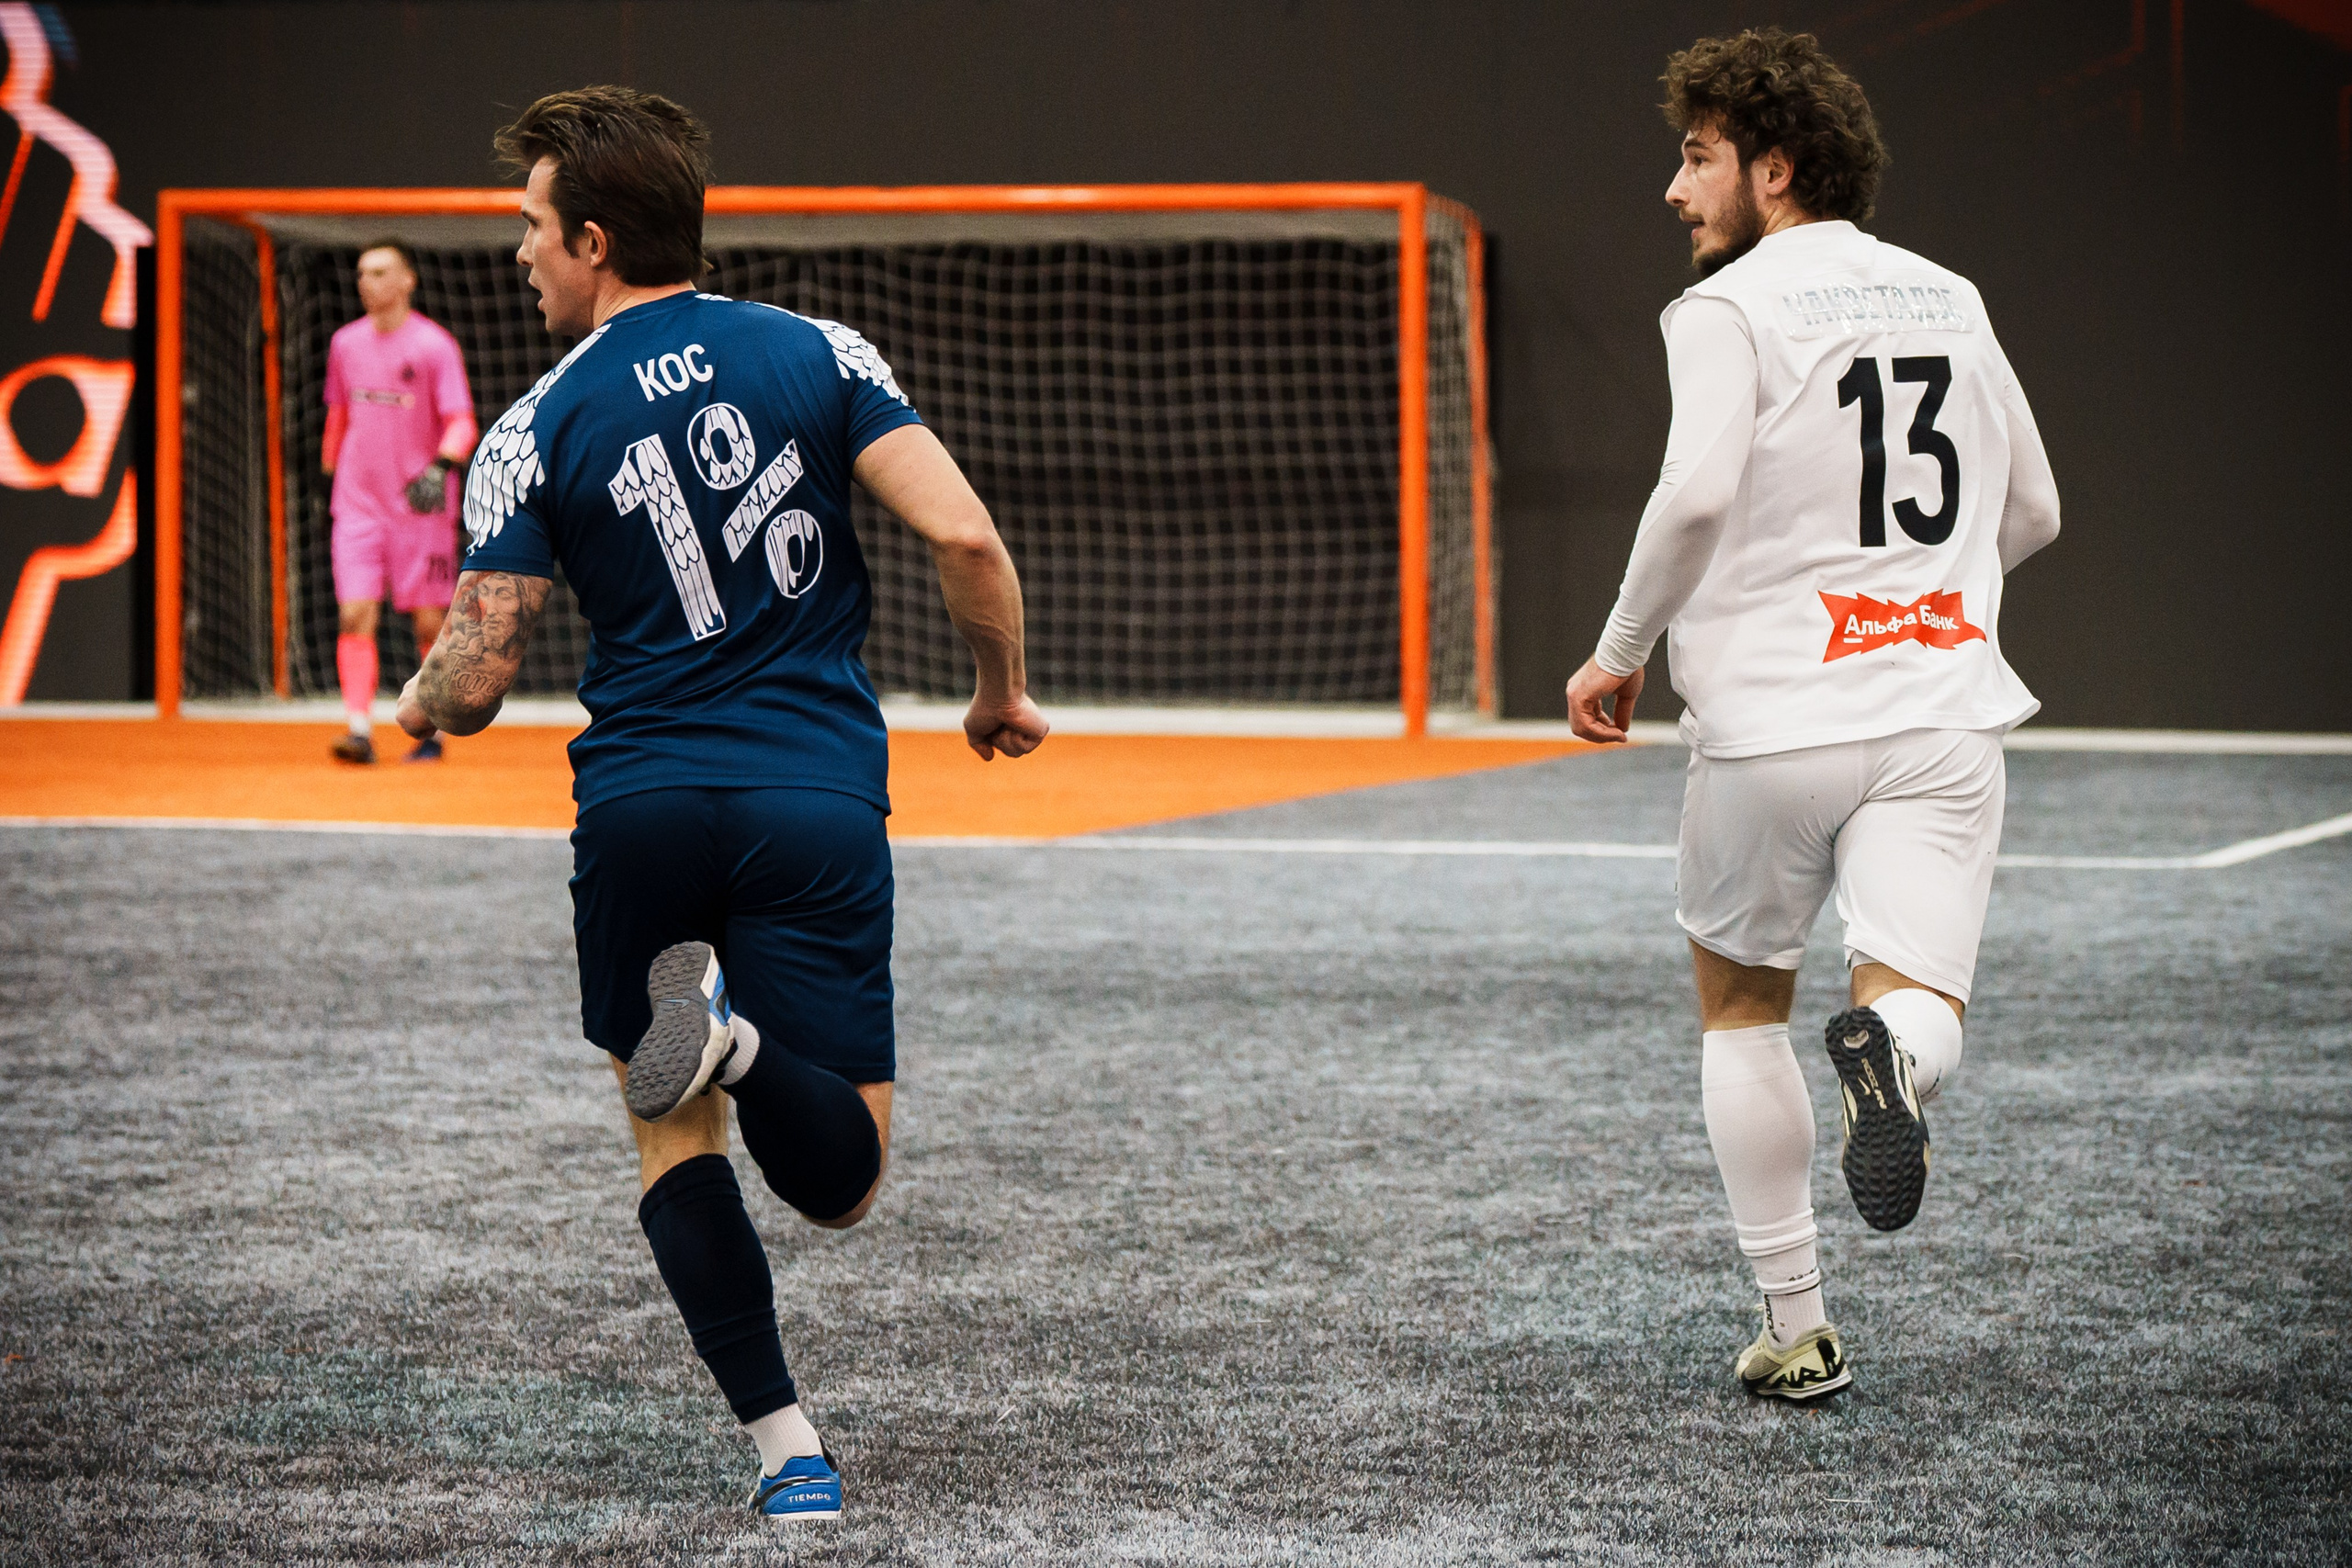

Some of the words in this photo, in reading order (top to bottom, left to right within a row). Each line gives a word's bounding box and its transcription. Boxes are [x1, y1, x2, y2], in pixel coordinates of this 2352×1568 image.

[1838, 355, 1960, 547] 13
[607, 402, 823, 641] 1%
[1843, 613, 1918, 636] Альфа
[1919, 604, 1960, 631] Банк
[788, 1493, 831, 1503] TIEMPO
